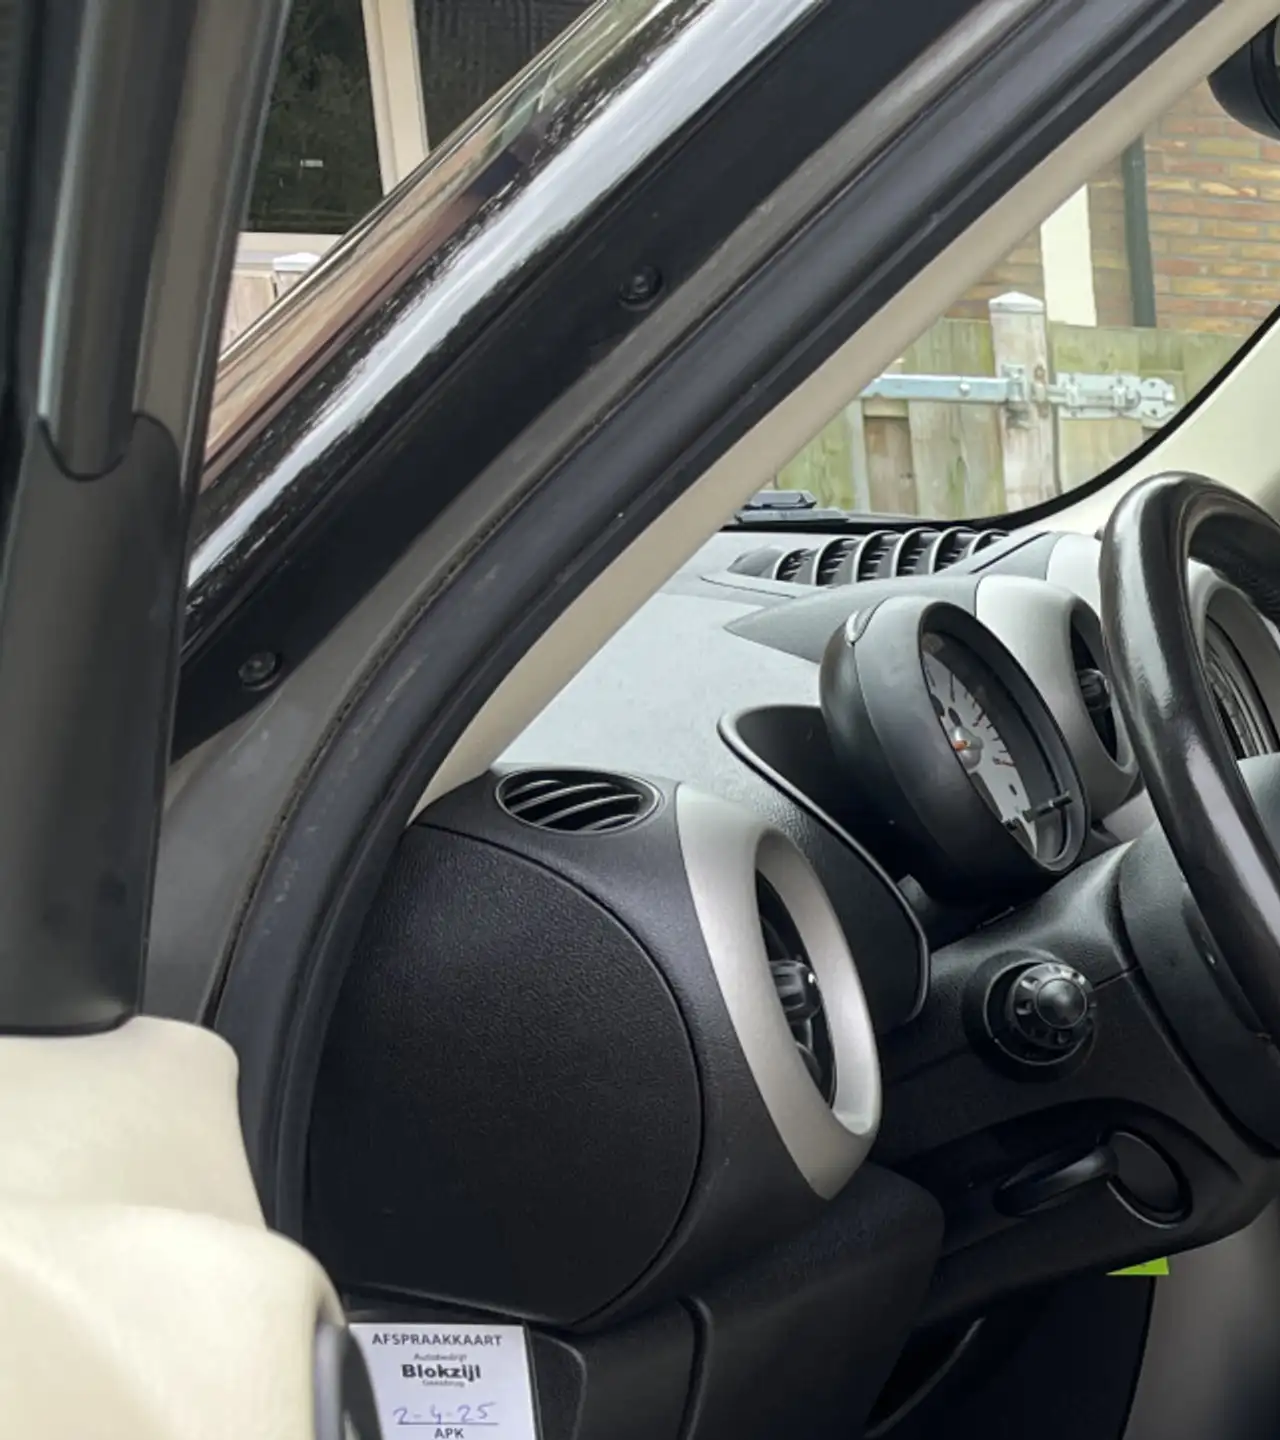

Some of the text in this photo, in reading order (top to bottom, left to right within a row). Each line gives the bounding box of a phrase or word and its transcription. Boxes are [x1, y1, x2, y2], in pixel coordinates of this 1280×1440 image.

[372, 1333, 502, 1347] AFSPRAAKKAART
[402, 1364, 481, 1382] Blokzijl
[434, 1428, 464, 1439] APK
